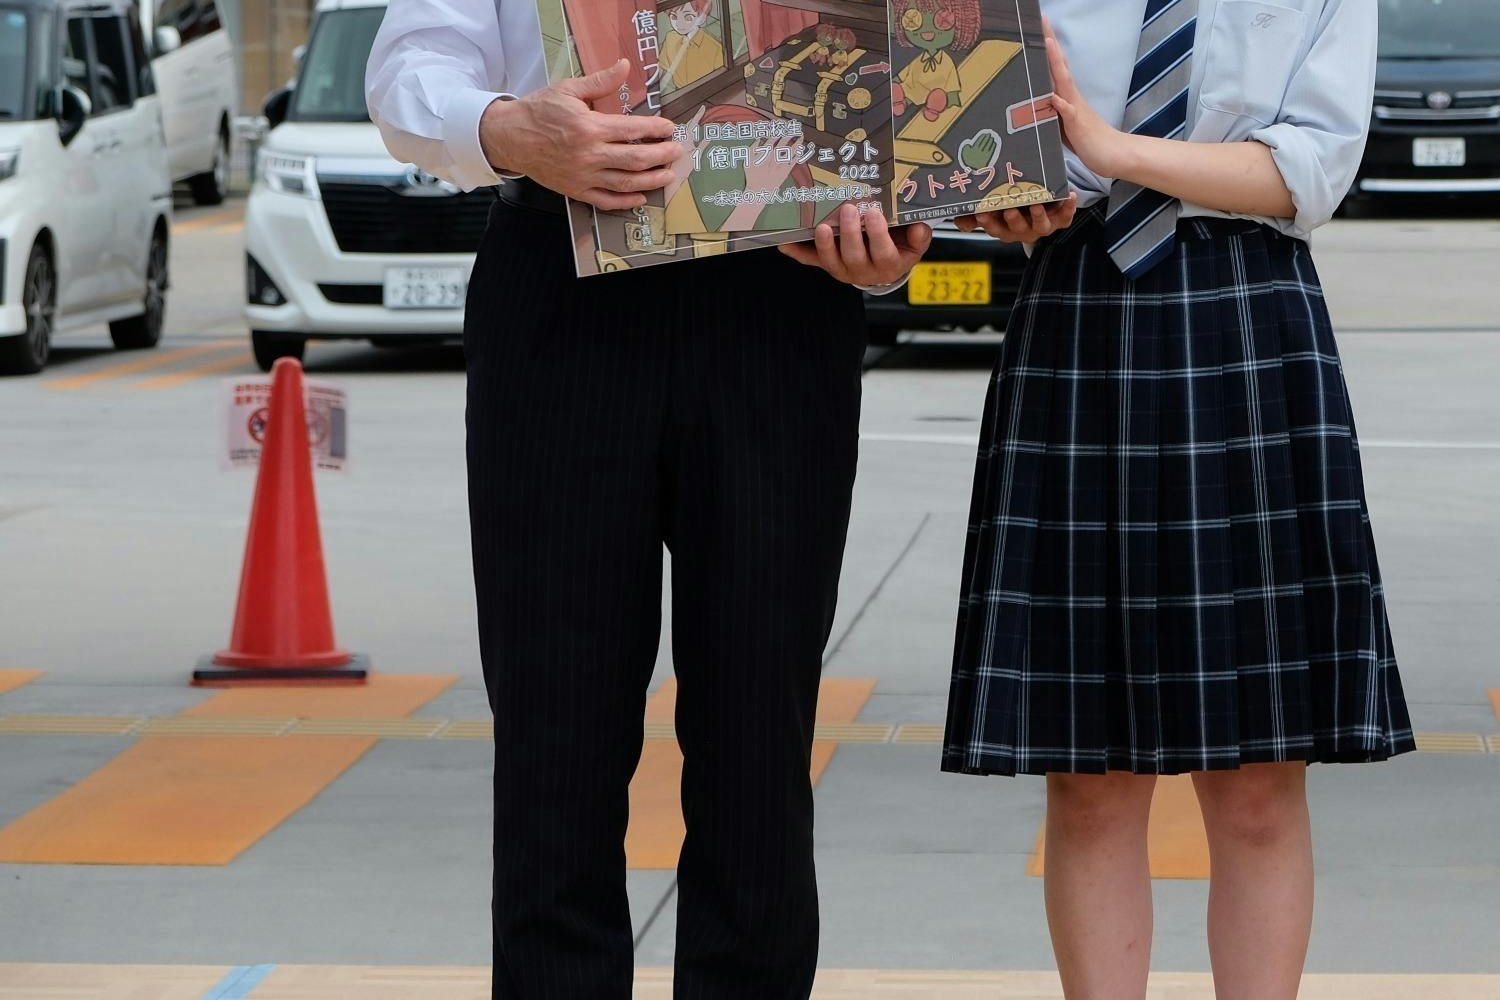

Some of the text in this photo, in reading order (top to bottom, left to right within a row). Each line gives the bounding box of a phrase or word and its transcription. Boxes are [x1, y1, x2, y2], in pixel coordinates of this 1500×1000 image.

[672, 120, 804, 143] 第1回全国高校生
[691, 140, 879, 172] 1億円プロジェクト
[838, 164, 880, 181] 2022
[927, 281, 984, 301] 23-22
